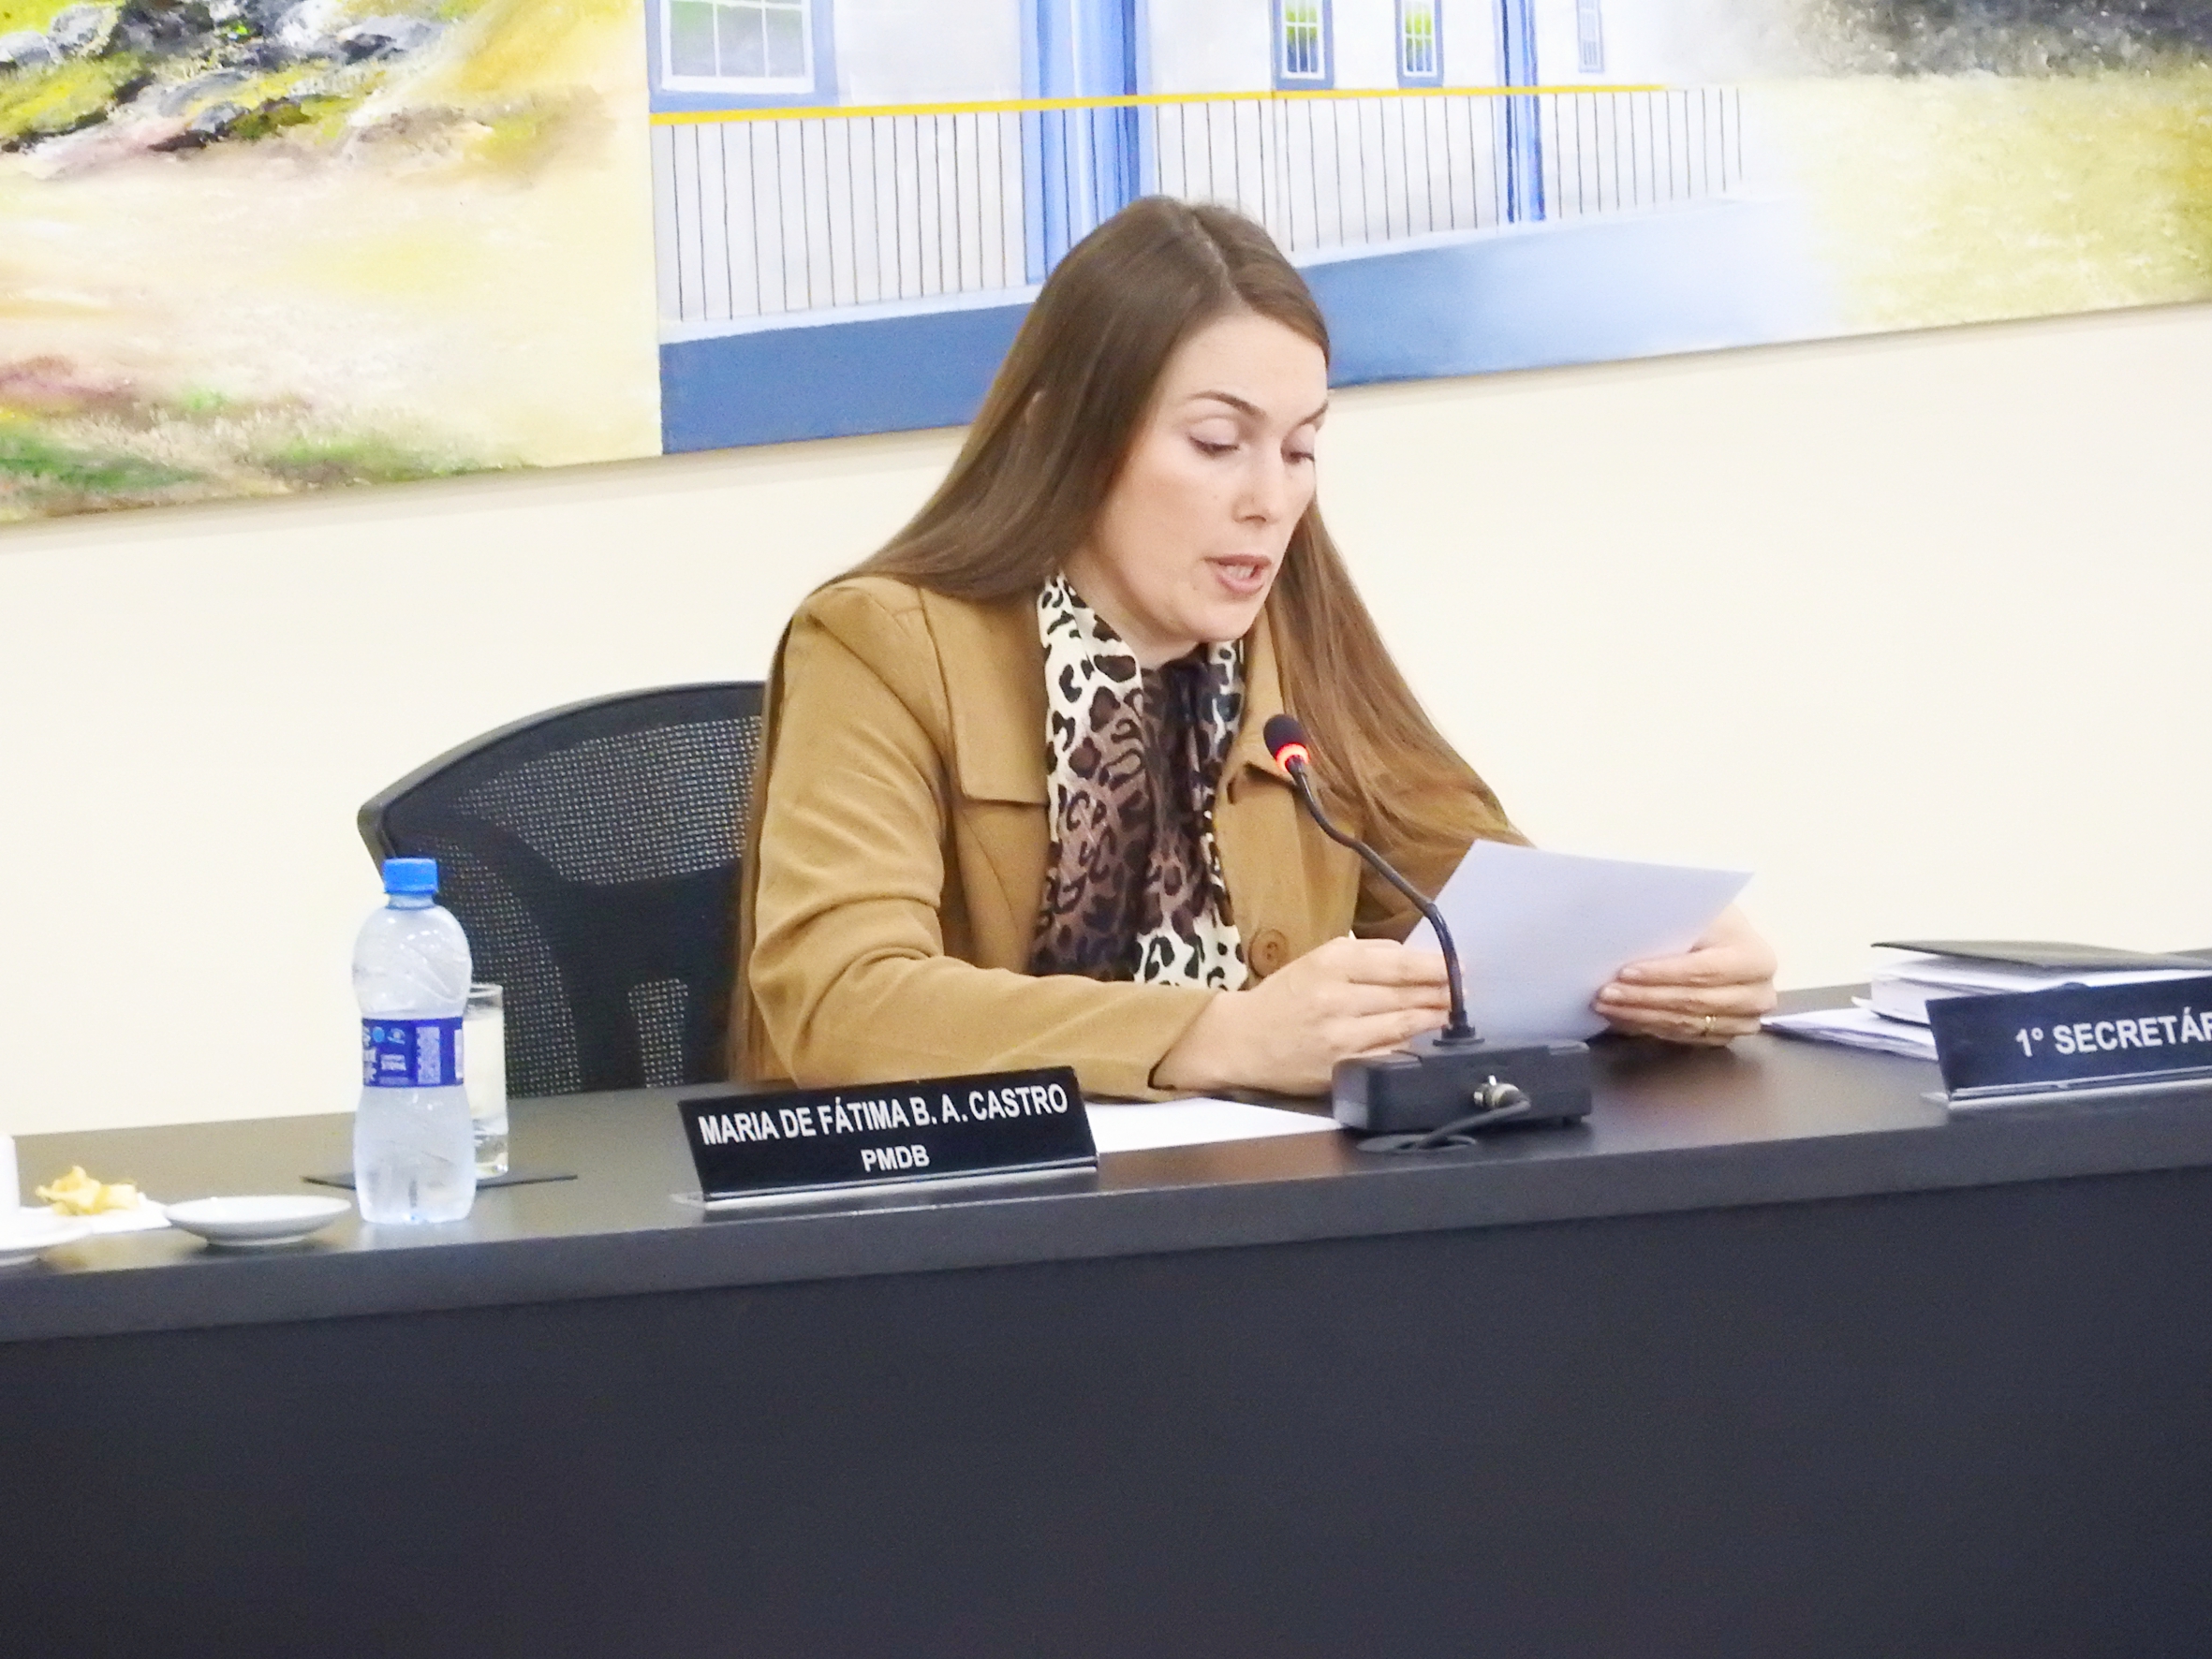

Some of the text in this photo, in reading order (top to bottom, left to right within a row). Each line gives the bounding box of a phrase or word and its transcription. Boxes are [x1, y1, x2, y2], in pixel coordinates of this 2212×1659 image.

[698, 1083, 1069, 1146] MARIA DE FÁTIMA B. A. CASTRO
[861, 1144, 930, 1172] PMDB
